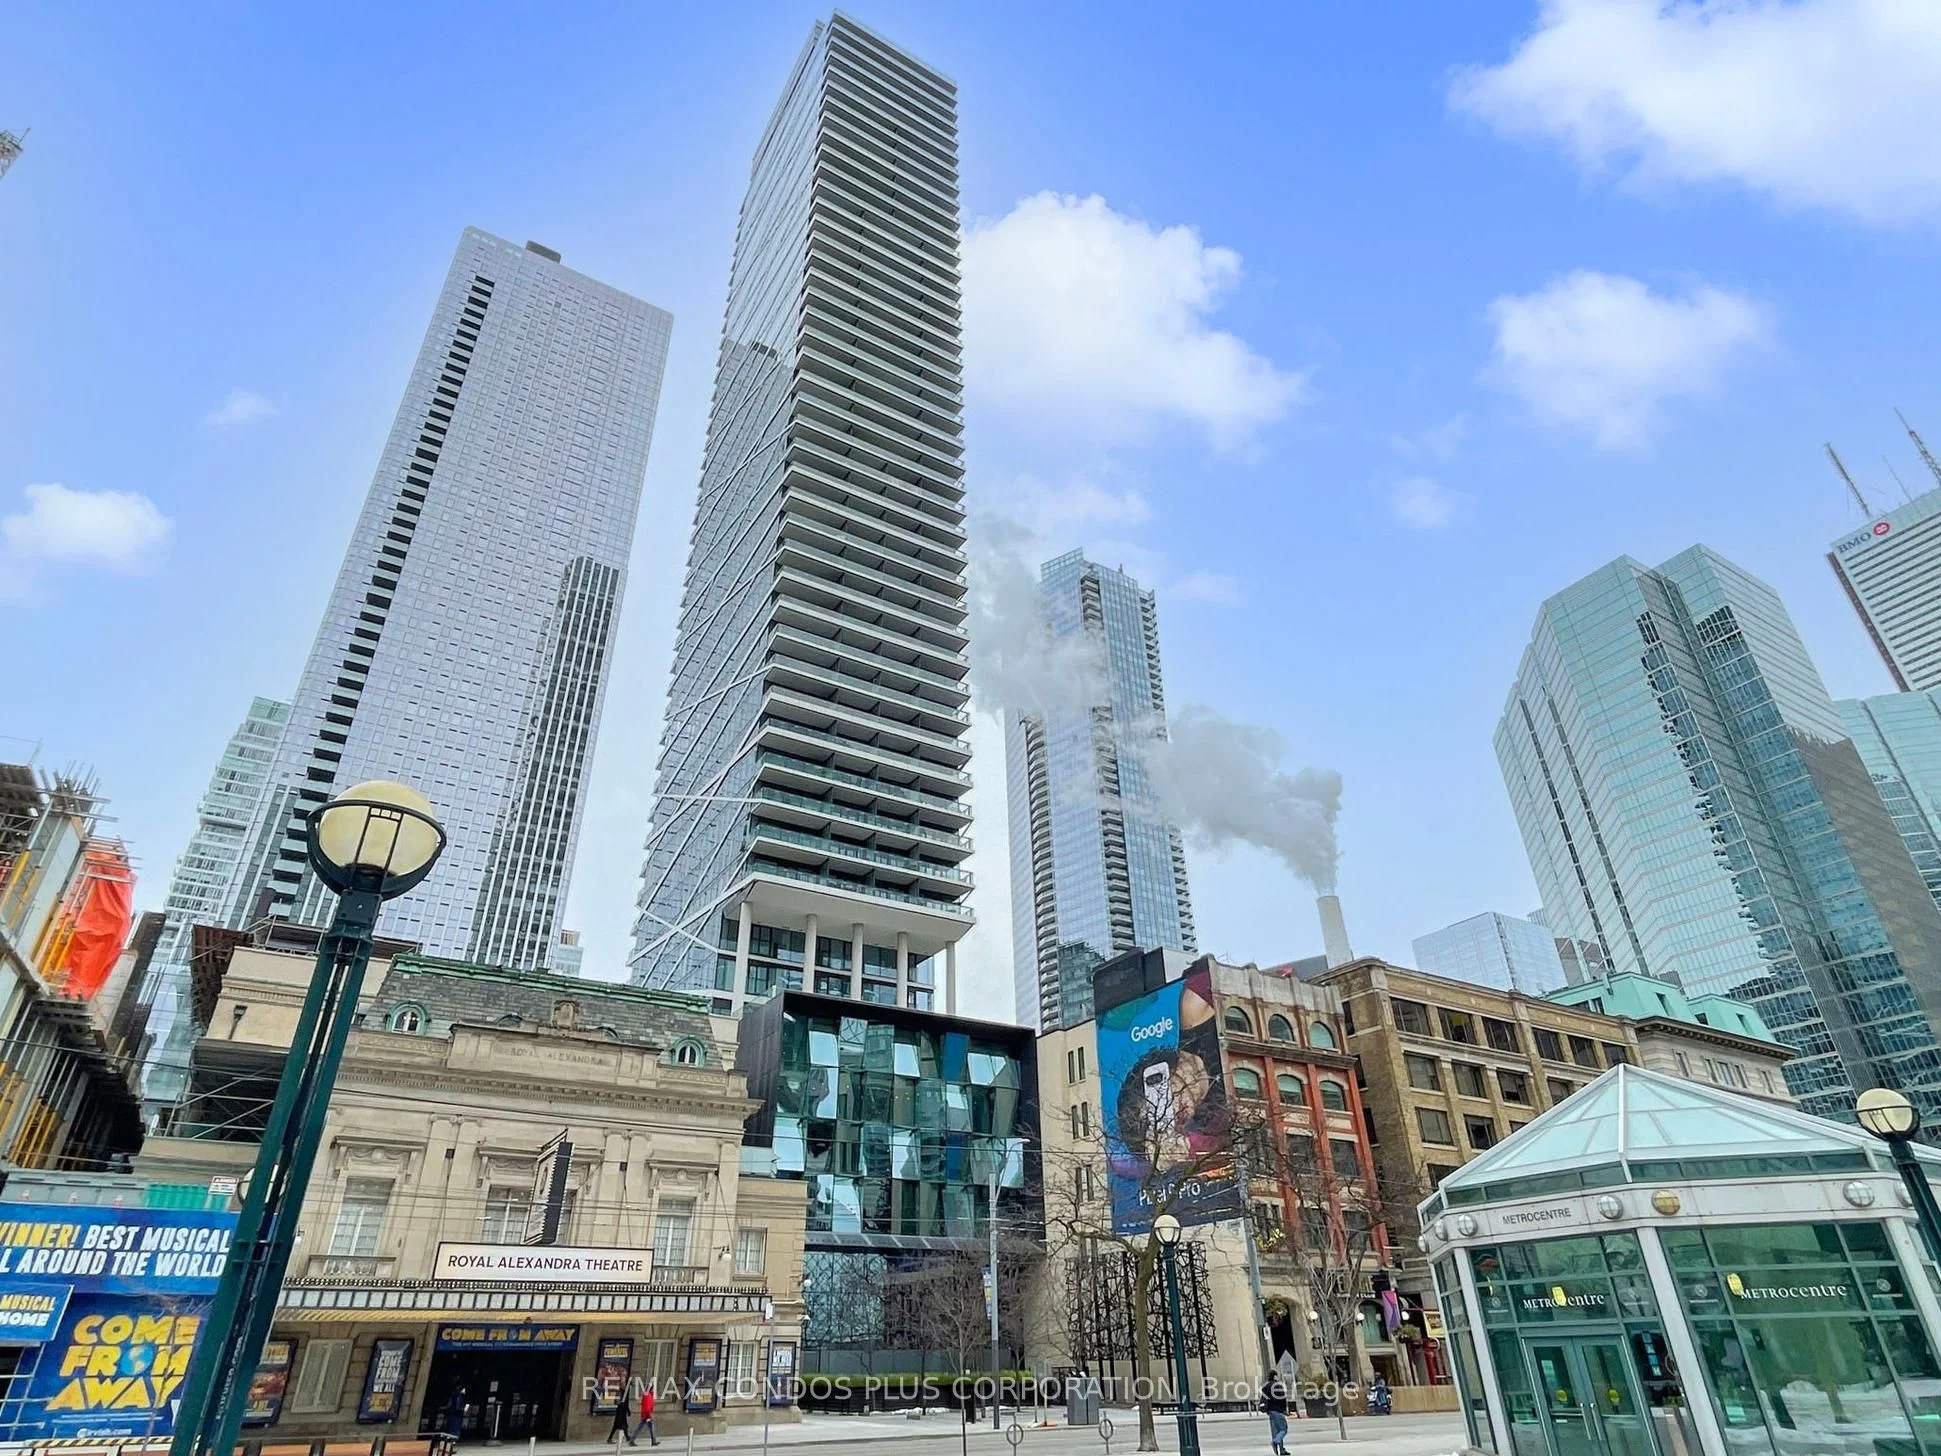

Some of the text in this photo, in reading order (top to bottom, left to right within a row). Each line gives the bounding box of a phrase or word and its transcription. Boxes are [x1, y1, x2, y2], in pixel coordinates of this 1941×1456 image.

[1839, 532, 1872, 553] BMO
[1131, 1016, 1173, 1041] Google
[1502, 1208, 1572, 1225] METROCENTRE
[83, 1224, 140, 1250] BEST
[140, 1227, 231, 1253] MUSICAL
[15, 1249, 107, 1275] AROUND
[111, 1252, 151, 1276] THE
[154, 1252, 227, 1277] WORLD
[448, 1255, 643, 1272] ROYAL ALEXANDRA THEATRE
[0, 1294, 56, 1311] MUSICAL
[1523, 1294, 1605, 1309] METRentre
[0, 1311, 50, 1327] HOME
[73, 1314, 200, 1345] COME
[441, 1328, 486, 1341] COME
[533, 1328, 576, 1341] AWAY
[44, 1376, 184, 1411] AWAY
